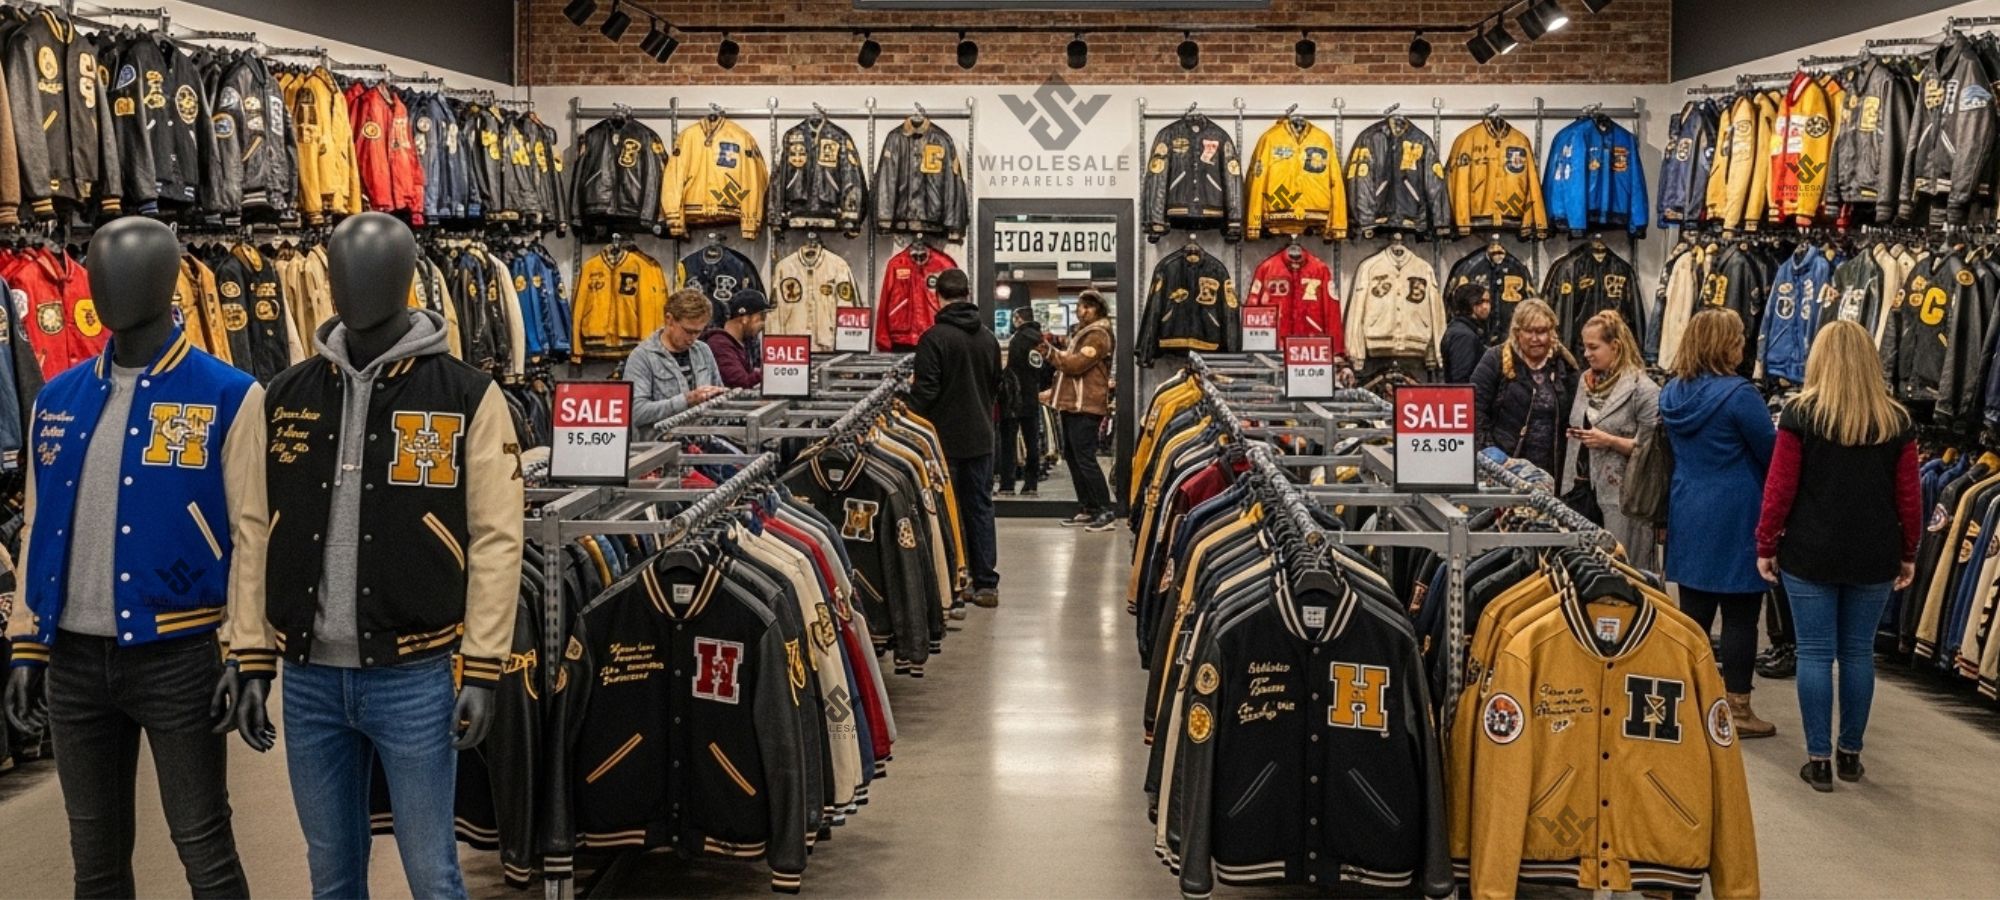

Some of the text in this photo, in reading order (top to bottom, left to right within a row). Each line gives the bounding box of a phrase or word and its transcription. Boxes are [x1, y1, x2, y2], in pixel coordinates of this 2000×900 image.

[1919, 287, 1946, 326] C
[766, 346, 805, 361] SALE
[1289, 345, 1329, 362] SALE
[142, 402, 217, 470] H
[560, 397, 624, 424] SALE
[1403, 403, 1468, 429] SALE
[388, 411, 465, 488] H
[692, 636, 744, 705] H
[1328, 661, 1390, 732] H
[1622, 673, 1685, 744] H
